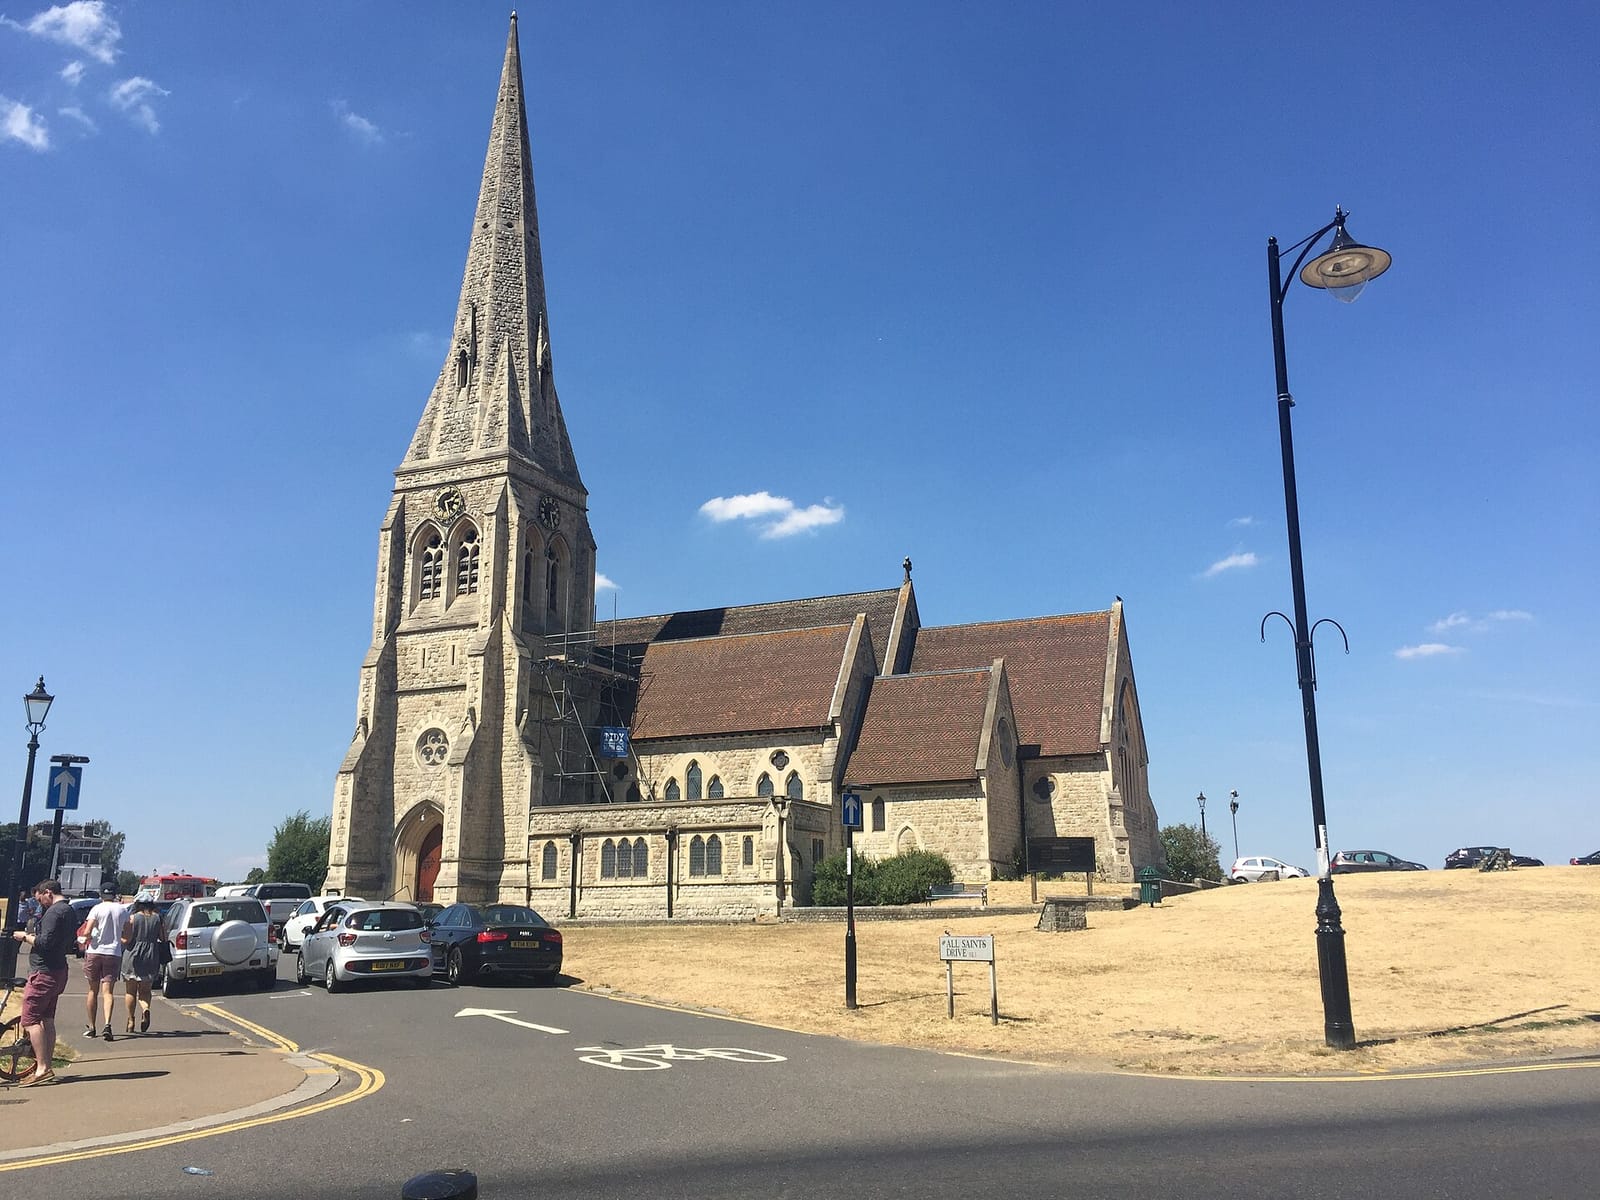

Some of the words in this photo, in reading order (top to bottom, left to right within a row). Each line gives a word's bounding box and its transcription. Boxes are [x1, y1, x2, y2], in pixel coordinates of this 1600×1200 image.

[946, 939, 960, 948] ALL
[961, 939, 987, 949] SAINTS
[946, 948, 968, 958] DRIVE
